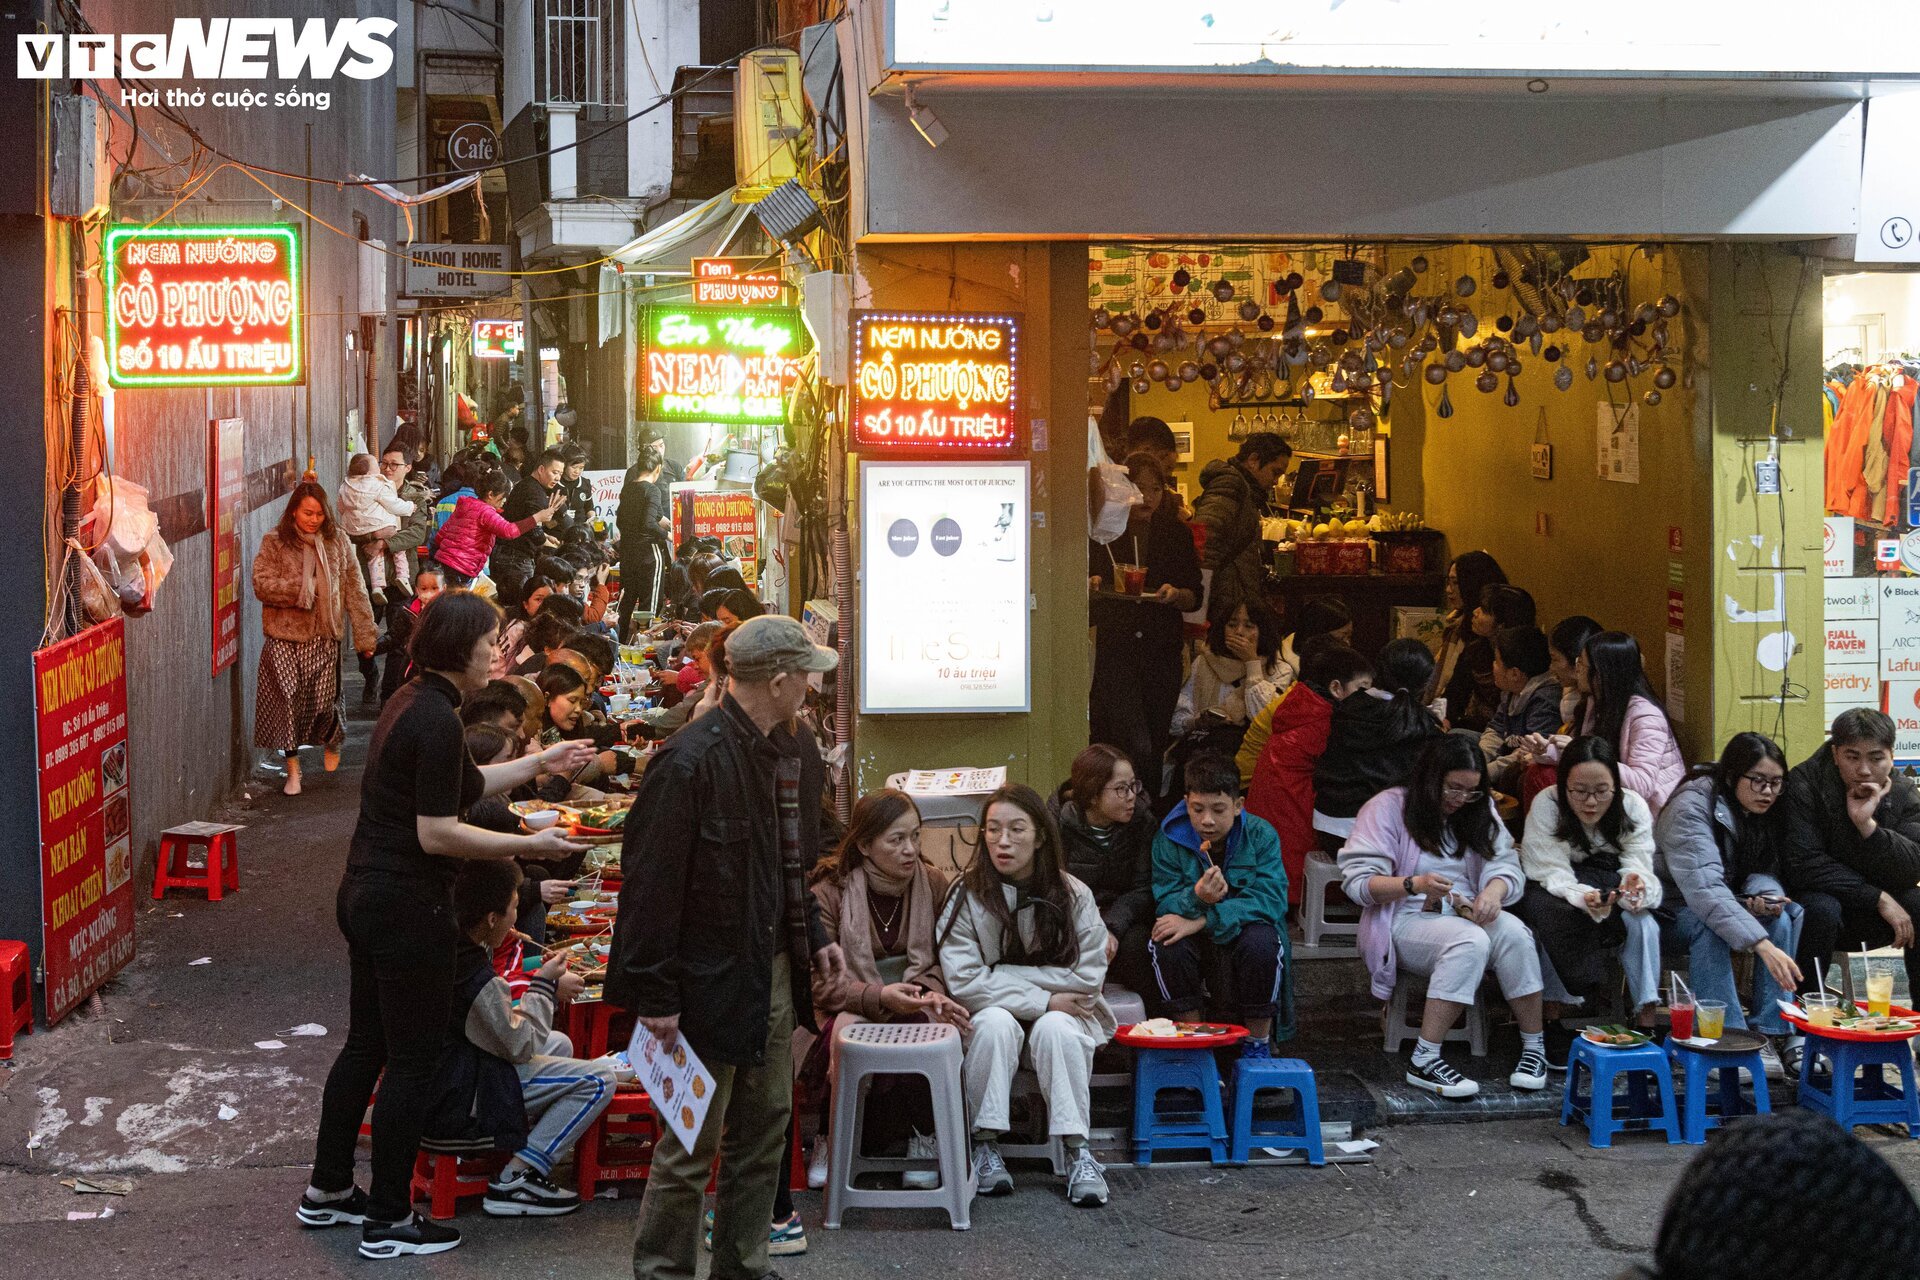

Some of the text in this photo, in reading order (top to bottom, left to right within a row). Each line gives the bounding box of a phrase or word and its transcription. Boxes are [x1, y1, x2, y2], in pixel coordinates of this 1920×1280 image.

[454, 136, 493, 160] Café
[128, 237, 277, 265] NEM NƯỚNG
[412, 251, 502, 269] HANOI HOME
[437, 272, 477, 287] HOTEL
[116, 268, 293, 335] CÔ PHƯỢNG
[870, 324, 1001, 350] NEM NƯỚNG
[118, 336, 293, 373] SỐ 10 ẤU TRIỆU
[649, 353, 727, 395] NEM
[860, 351, 1011, 410] CÔ PHƯỢNG
[864, 408, 1006, 440] SỐ 10 ẤU TRIỆU
[1895, 588, 1920, 596] Black
[1828, 630, 1857, 640] FJALL
[1828, 640, 1866, 650] RAVEN
[42, 666, 59, 716] NEM
[59, 648, 85, 705] NƯỚNG
[85, 638, 95, 694] CÔ
[938, 667, 951, 679] 10
[48, 766, 96, 823] NEM NƯỚNG
[50, 822, 87, 878] NEM RÁN
[52, 864, 104, 931] KHOAI CHIÊN
[70, 906, 117, 962] MỰC NƯỚNG
[54, 977, 67, 1013] CÁ
[83, 956, 95, 990] CÁ
